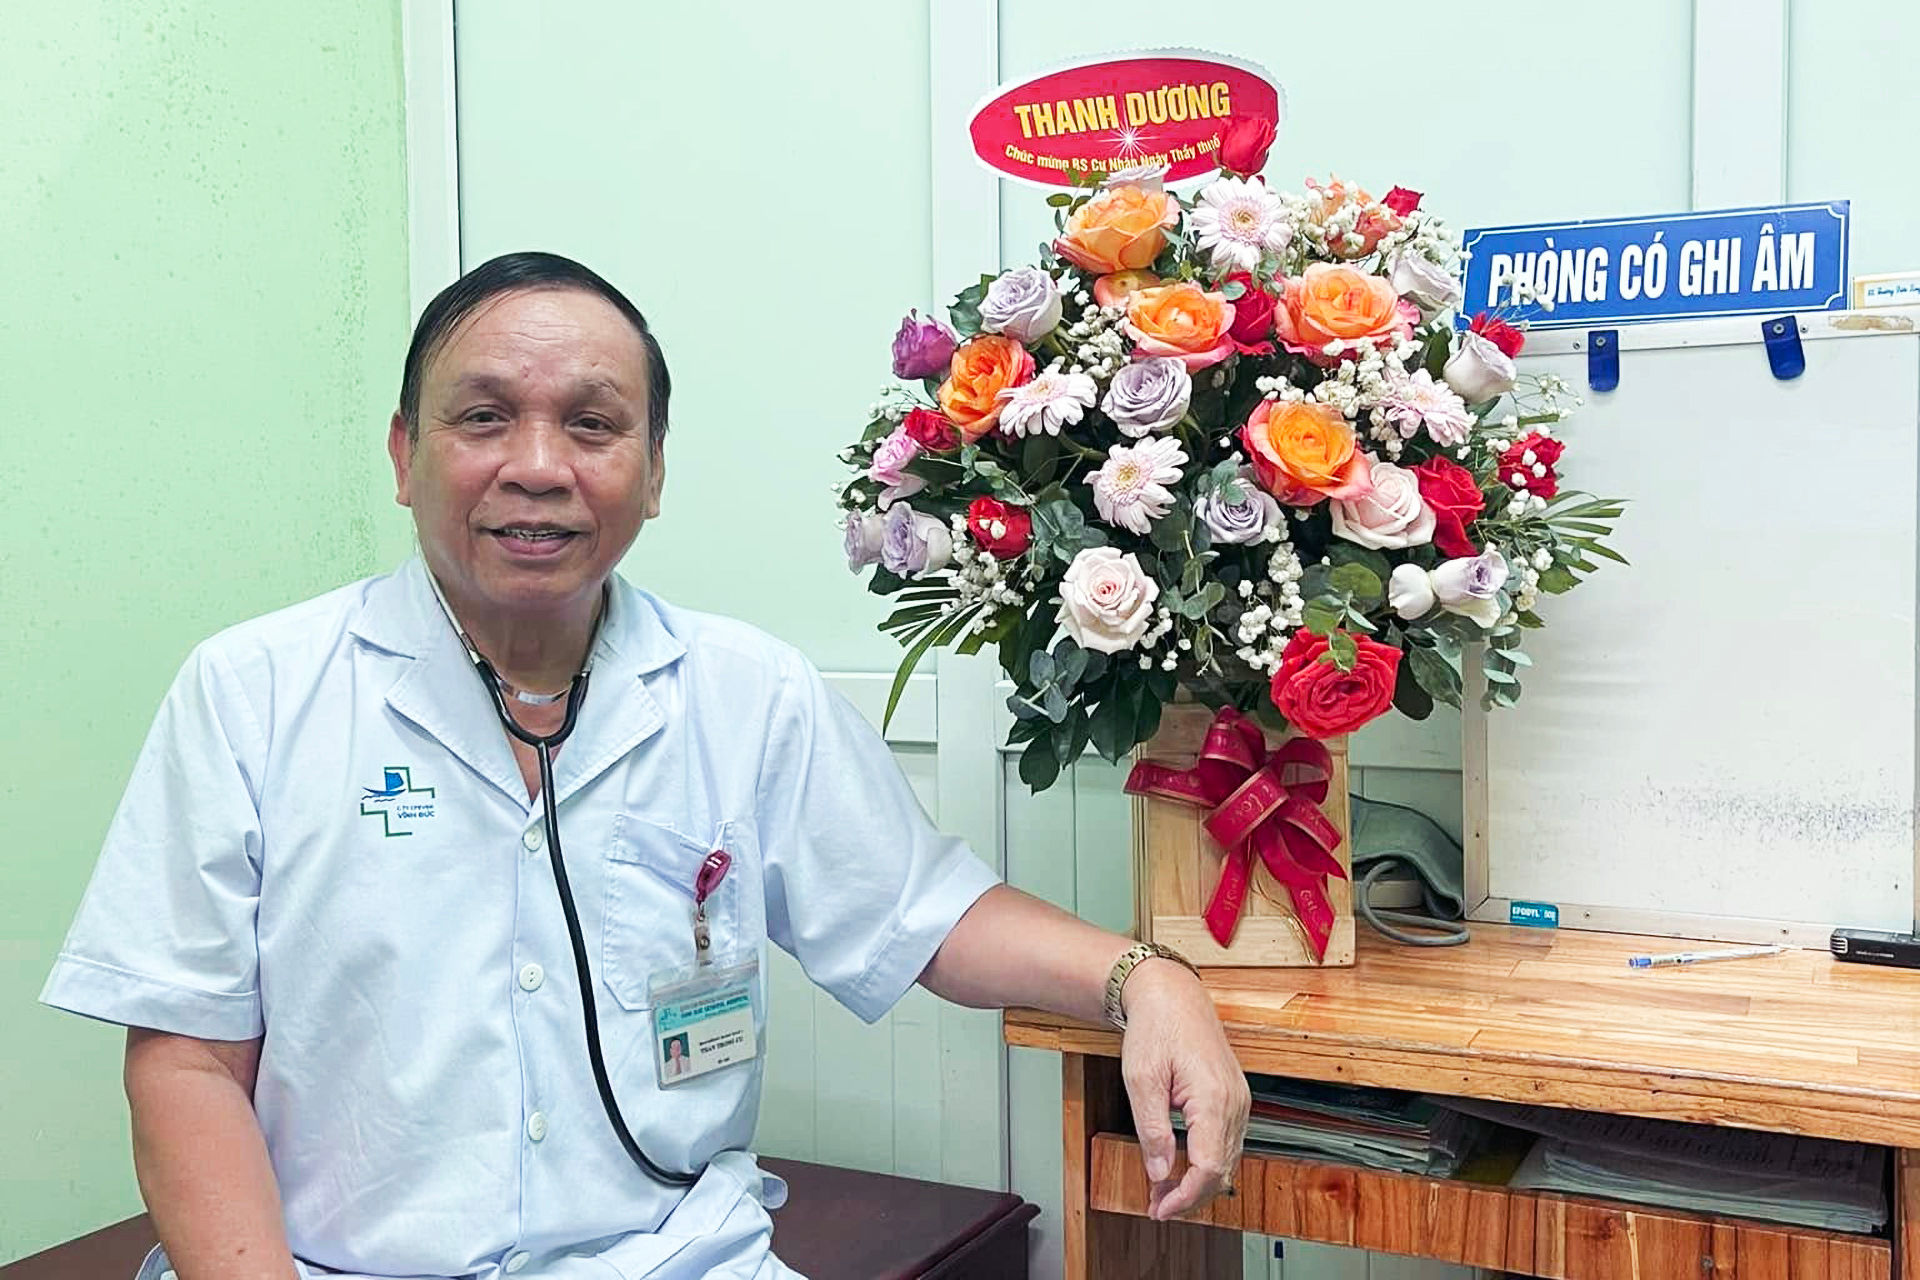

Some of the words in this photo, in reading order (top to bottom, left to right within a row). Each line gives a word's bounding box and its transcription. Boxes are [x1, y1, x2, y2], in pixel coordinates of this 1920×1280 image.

[1014, 96, 1119, 139] THANH
[1125, 82, 1231, 127] DƯƠNG
[1005, 144, 1035, 165] Chúc
[1197, 131, 1221, 154] thuố
[1487, 237, 1609, 308] PHÒNG
[1619, 231, 1668, 301] CÓ
[1678, 238, 1742, 297] GHI
[1751, 222, 1816, 292] ÂM
